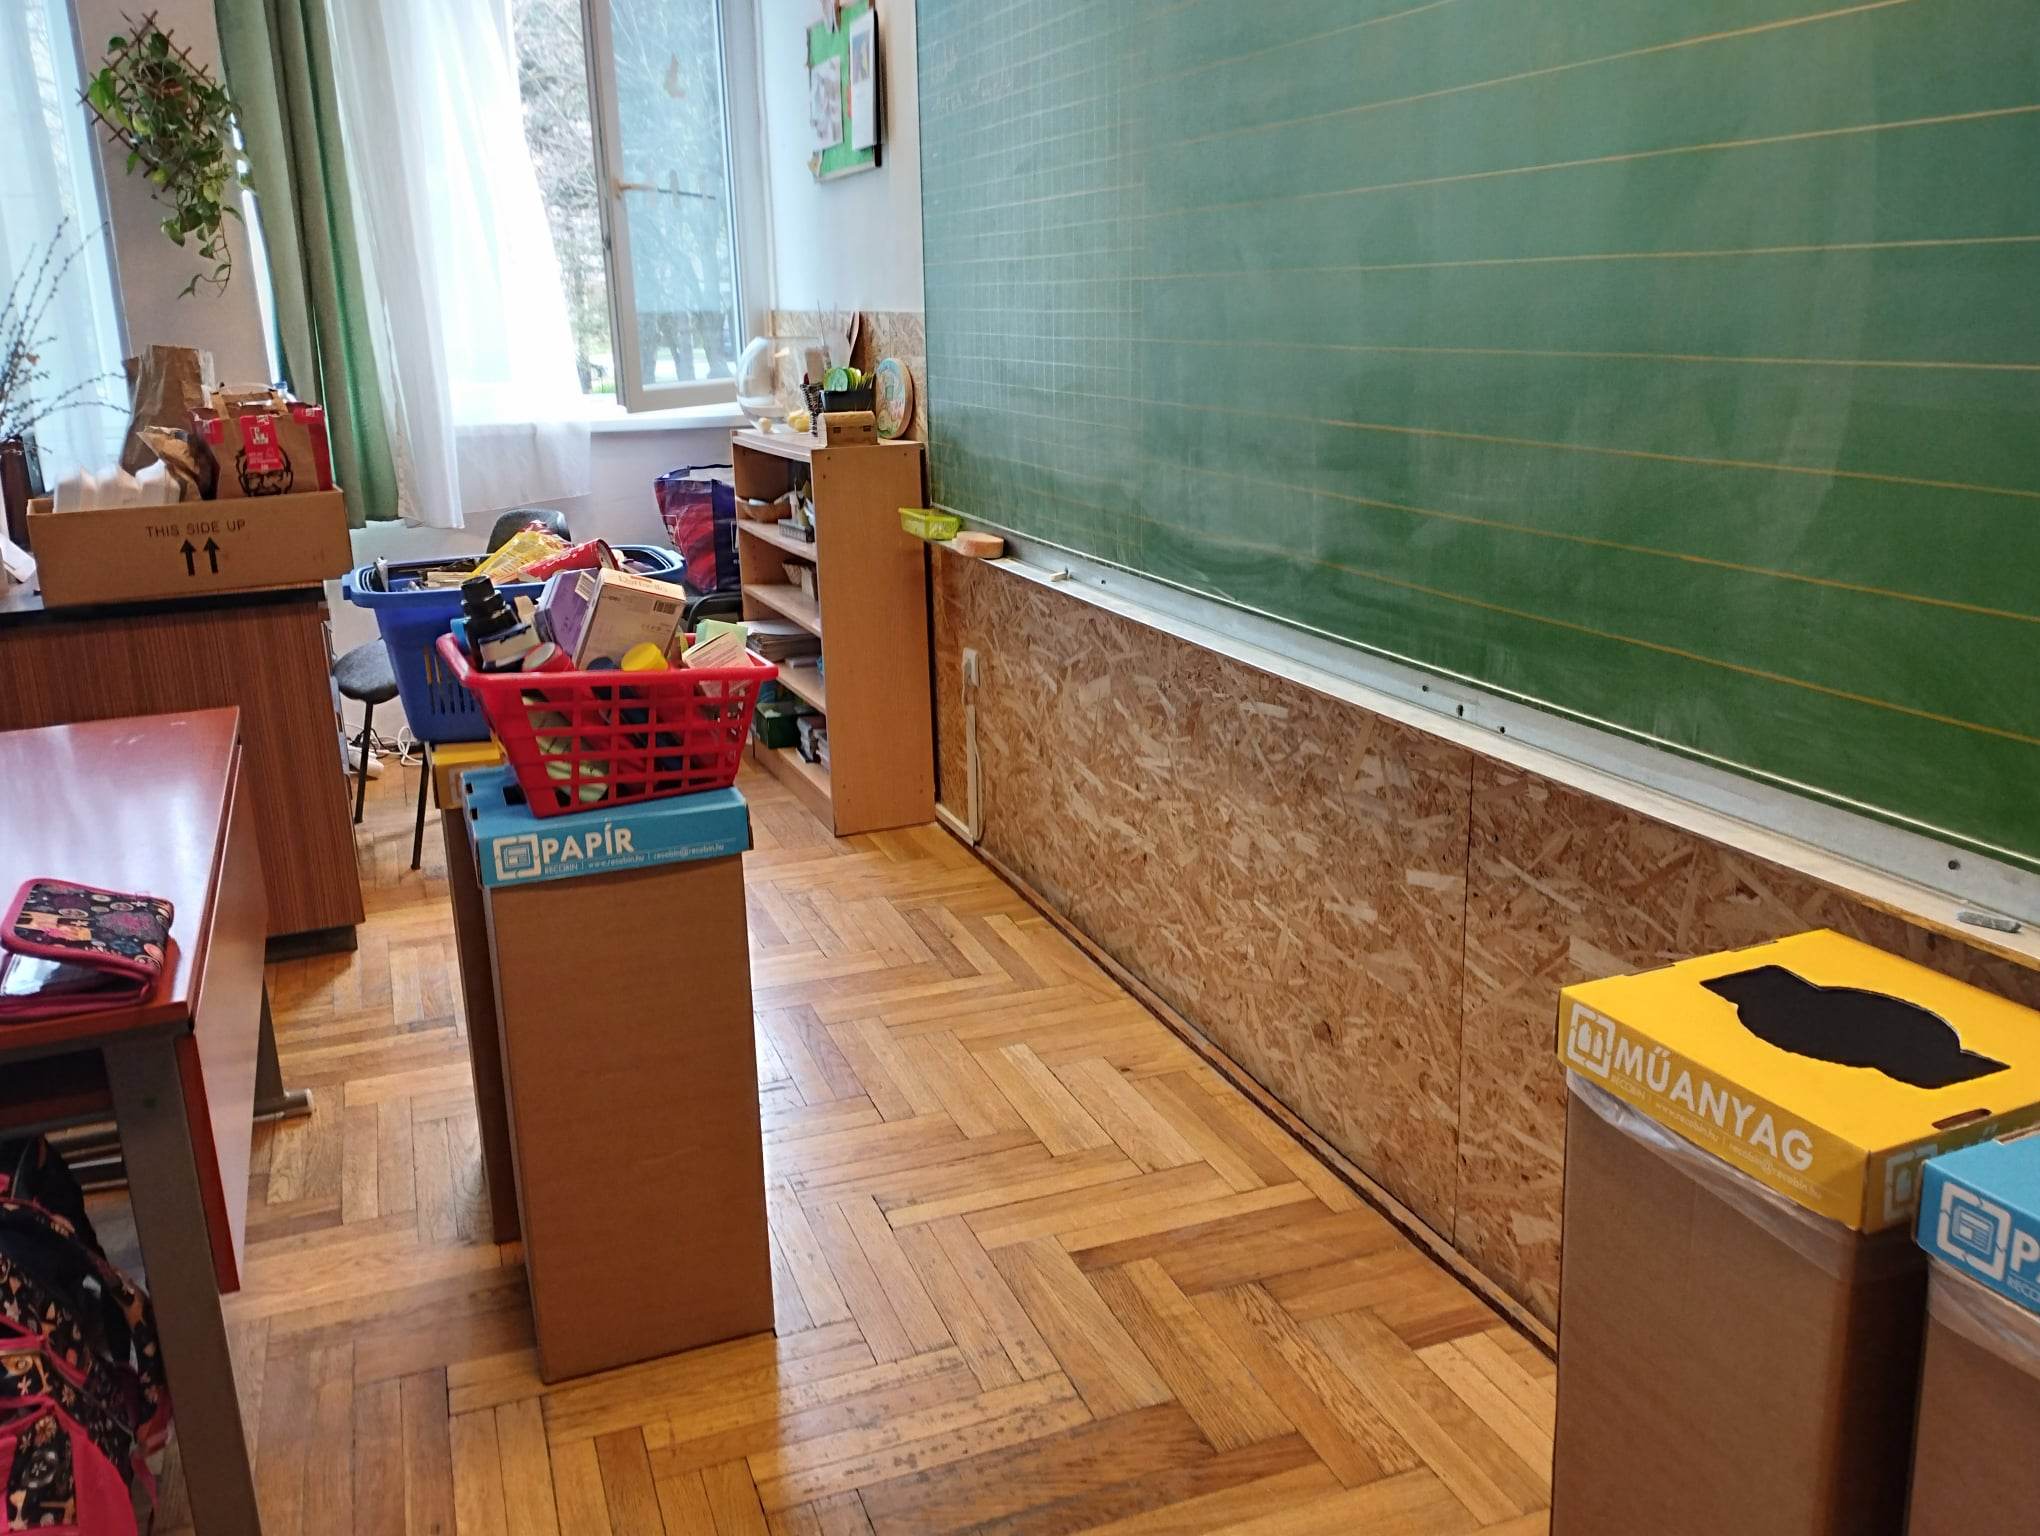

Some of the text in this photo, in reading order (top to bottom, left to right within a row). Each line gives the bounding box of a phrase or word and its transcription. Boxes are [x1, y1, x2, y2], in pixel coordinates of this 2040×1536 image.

[145, 518, 247, 538] THIS SIDE UP
[541, 817, 635, 865] PAPÍR
[1613, 1037, 1815, 1171] MŰANYAG
